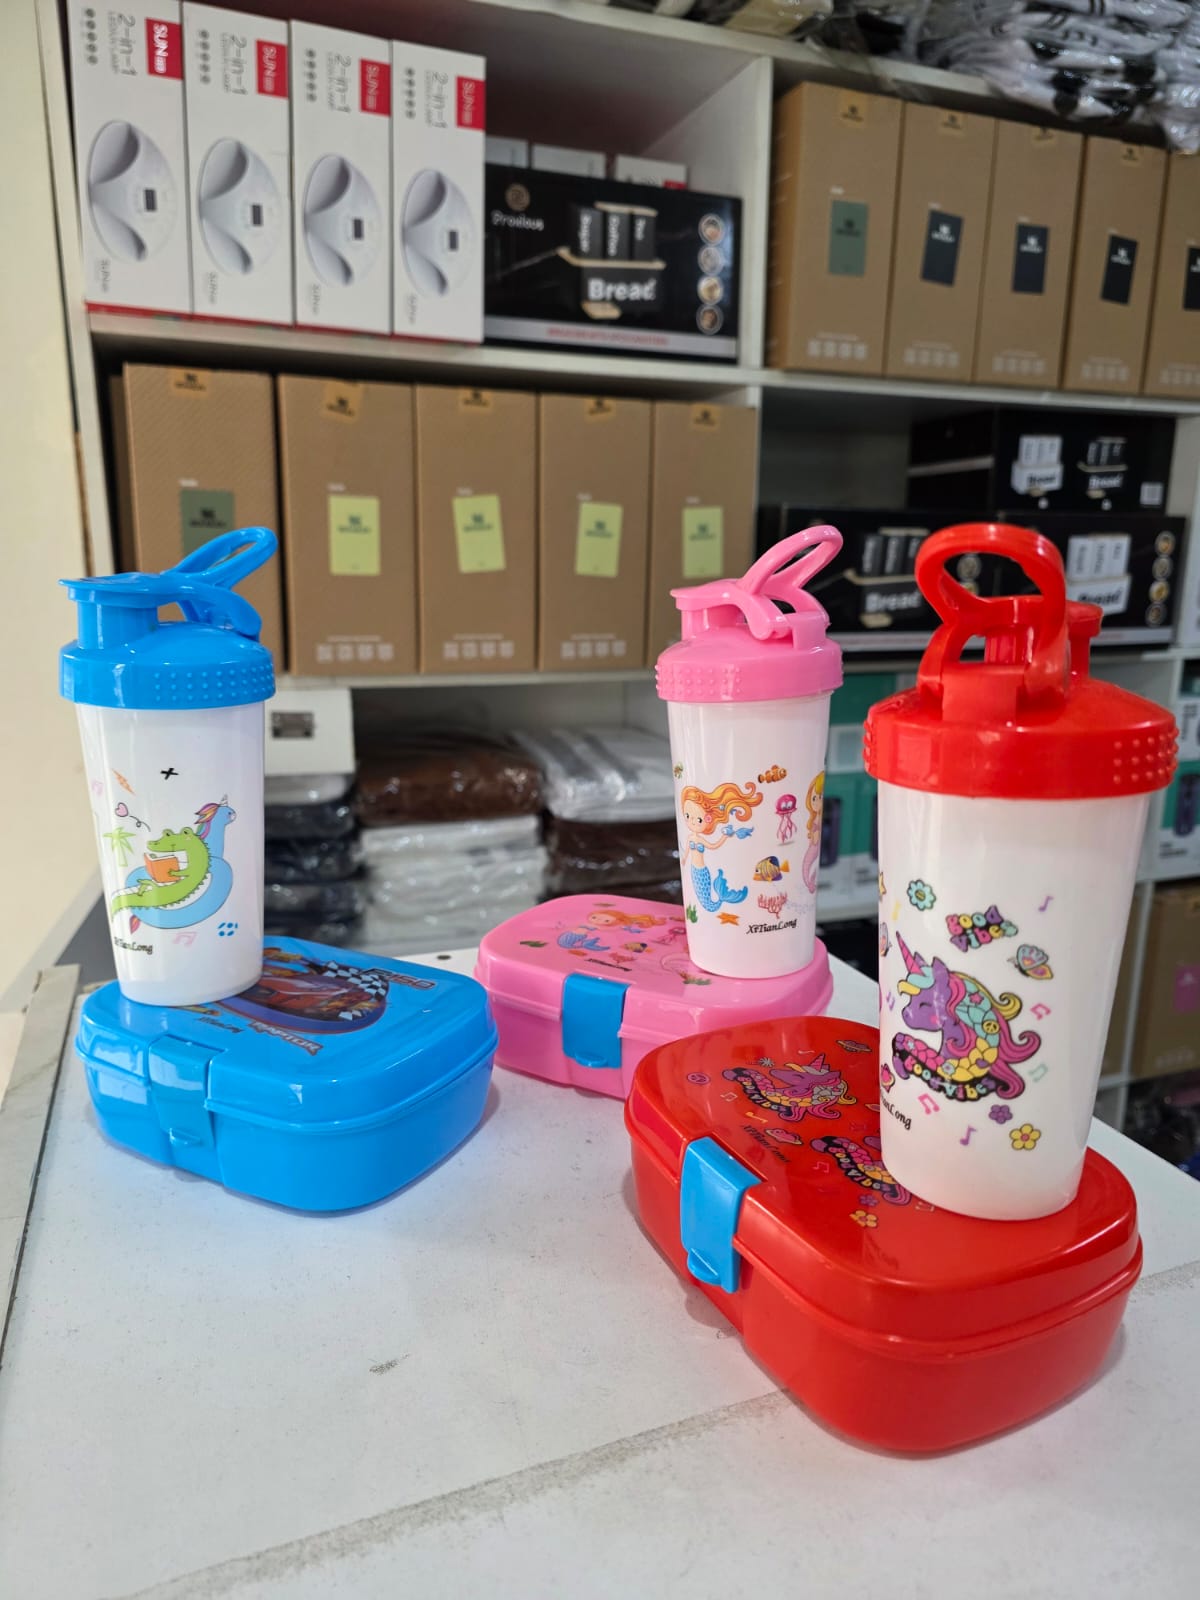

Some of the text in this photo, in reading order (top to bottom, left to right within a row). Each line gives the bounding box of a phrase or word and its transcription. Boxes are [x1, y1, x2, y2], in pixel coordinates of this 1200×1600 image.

[117, 14, 137, 76] 2-in-1
[231, 34, 249, 96] 2-in-1
[335, 54, 352, 113] 2-in-1
[432, 71, 449, 128] 2-in-1
[587, 277, 657, 301] Bread
[248, 1020, 324, 1056] RAPTOR
